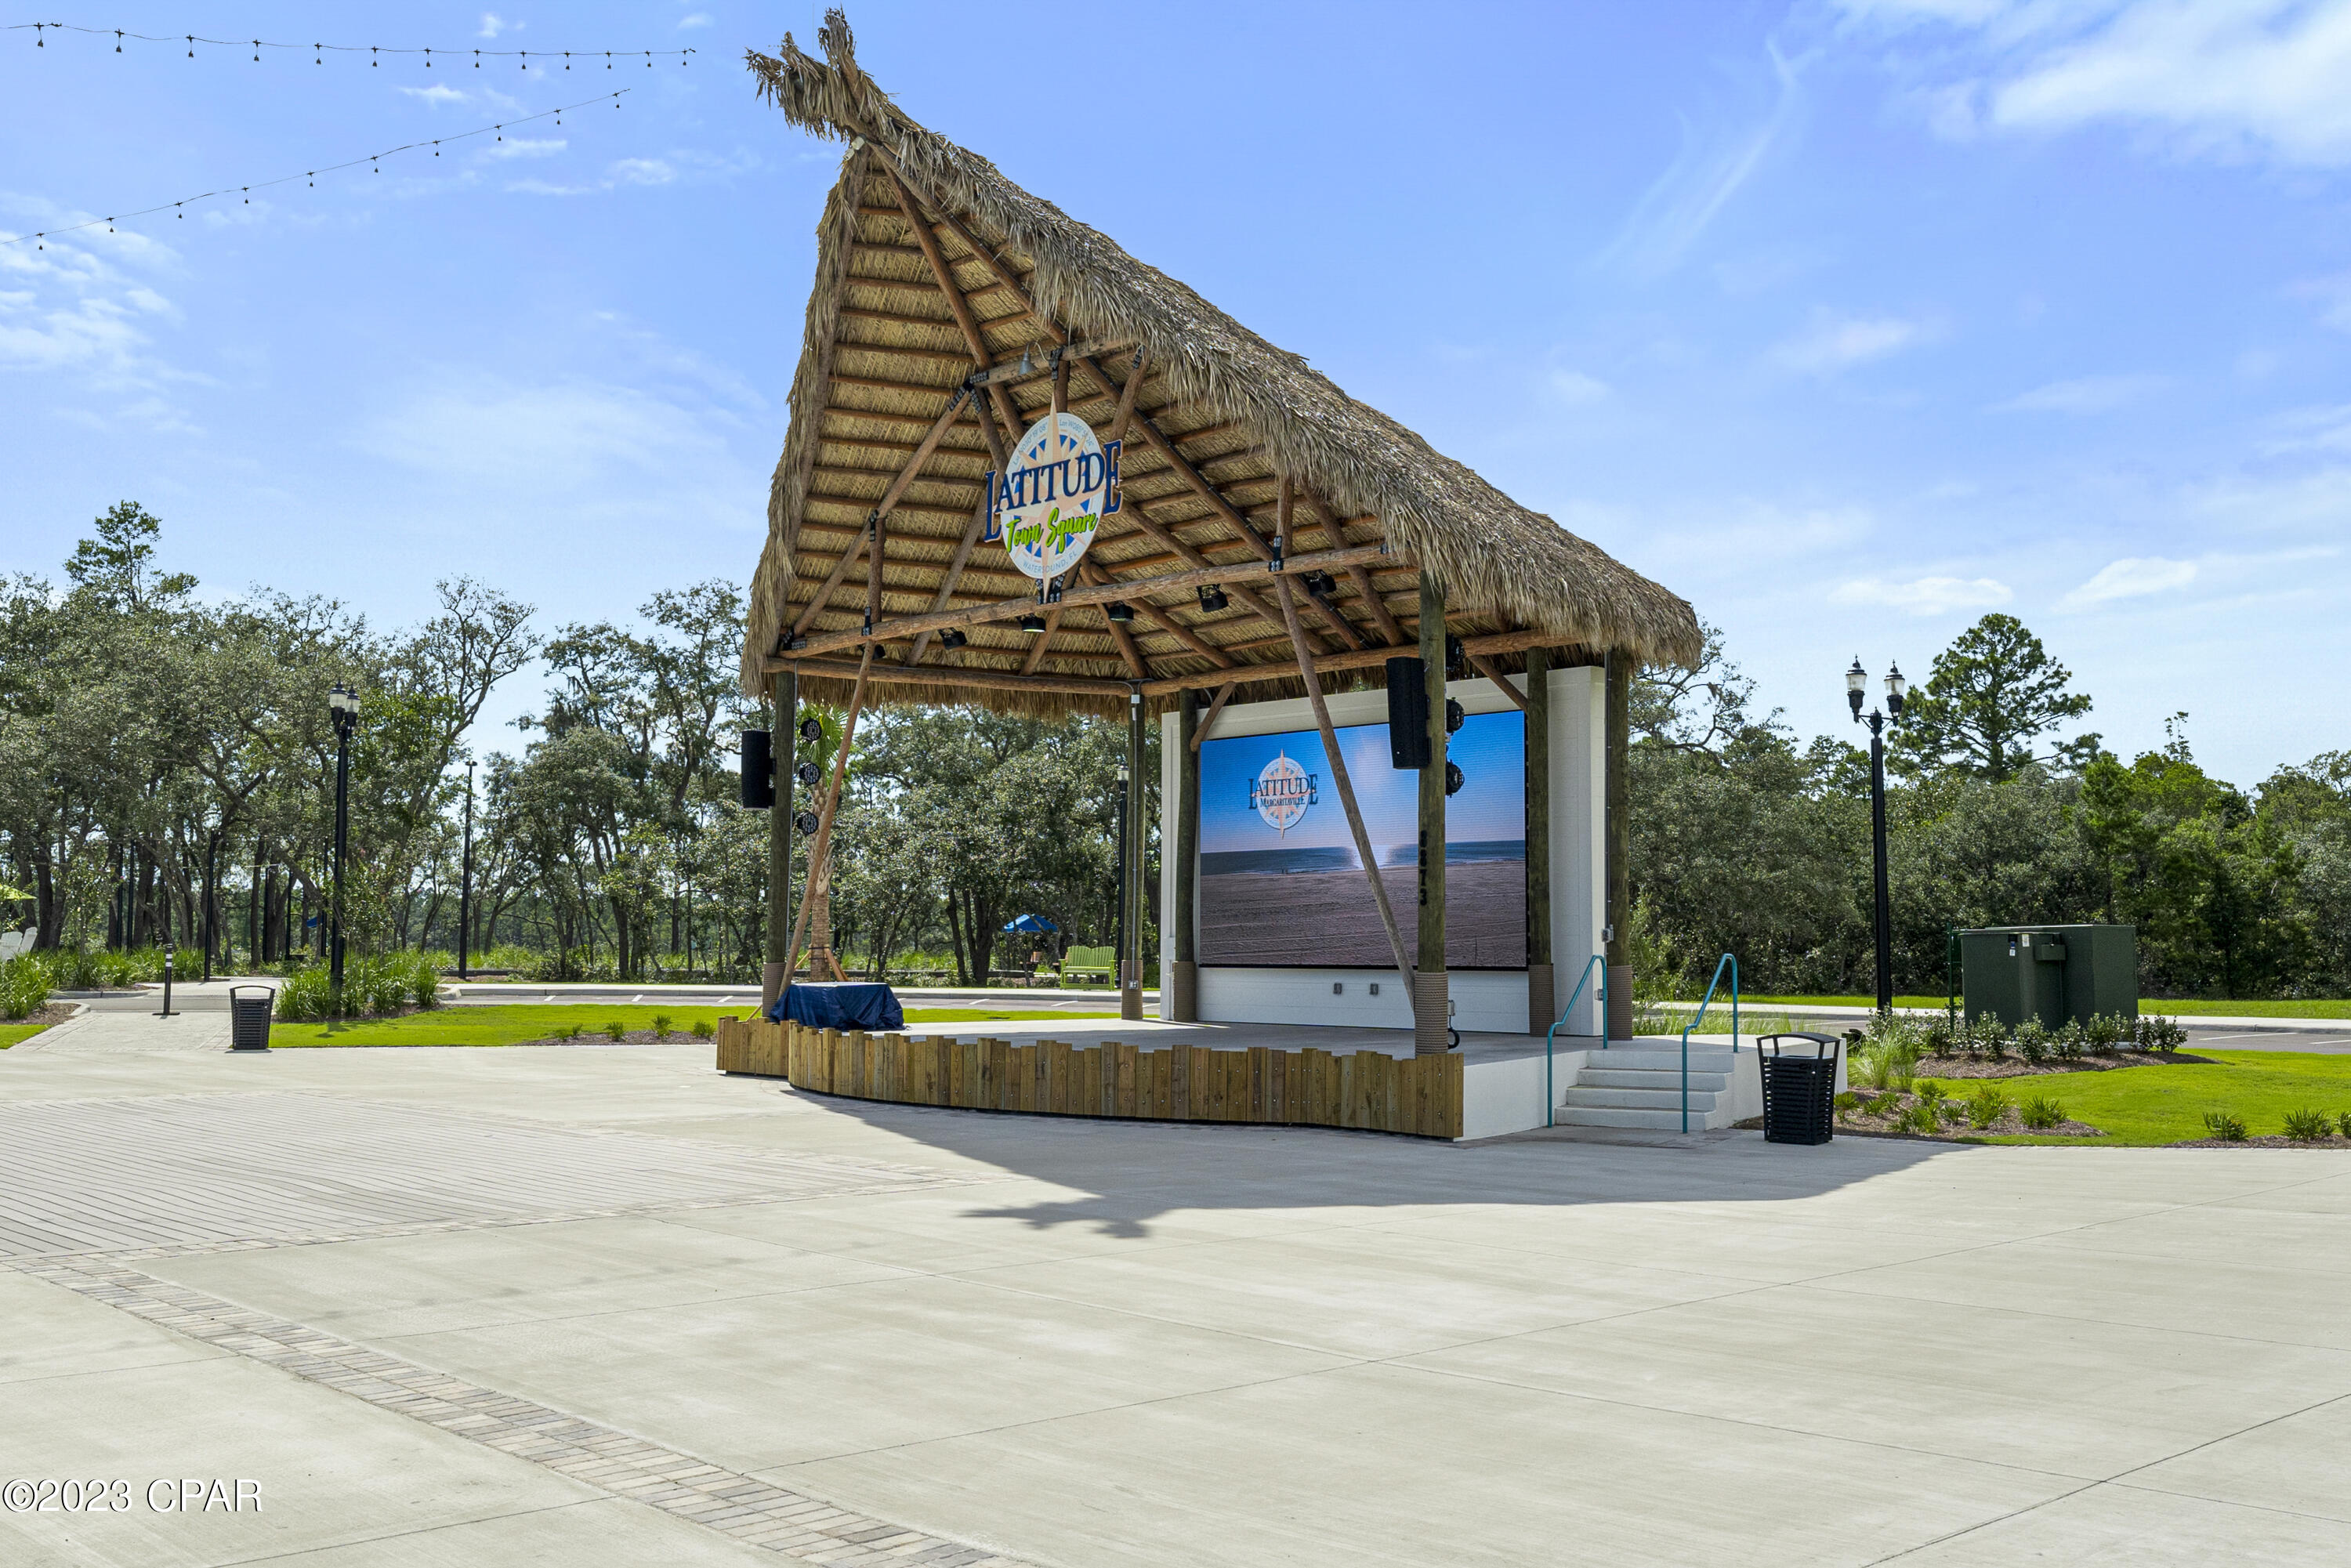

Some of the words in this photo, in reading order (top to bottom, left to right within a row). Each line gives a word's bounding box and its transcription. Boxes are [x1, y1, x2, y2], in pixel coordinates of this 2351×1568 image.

[984, 439, 1122, 542] LATITUDE
[1006, 518, 1043, 552] Town
[1045, 507, 1099, 553] Square
[1248, 774, 1318, 809] LATITUDE
